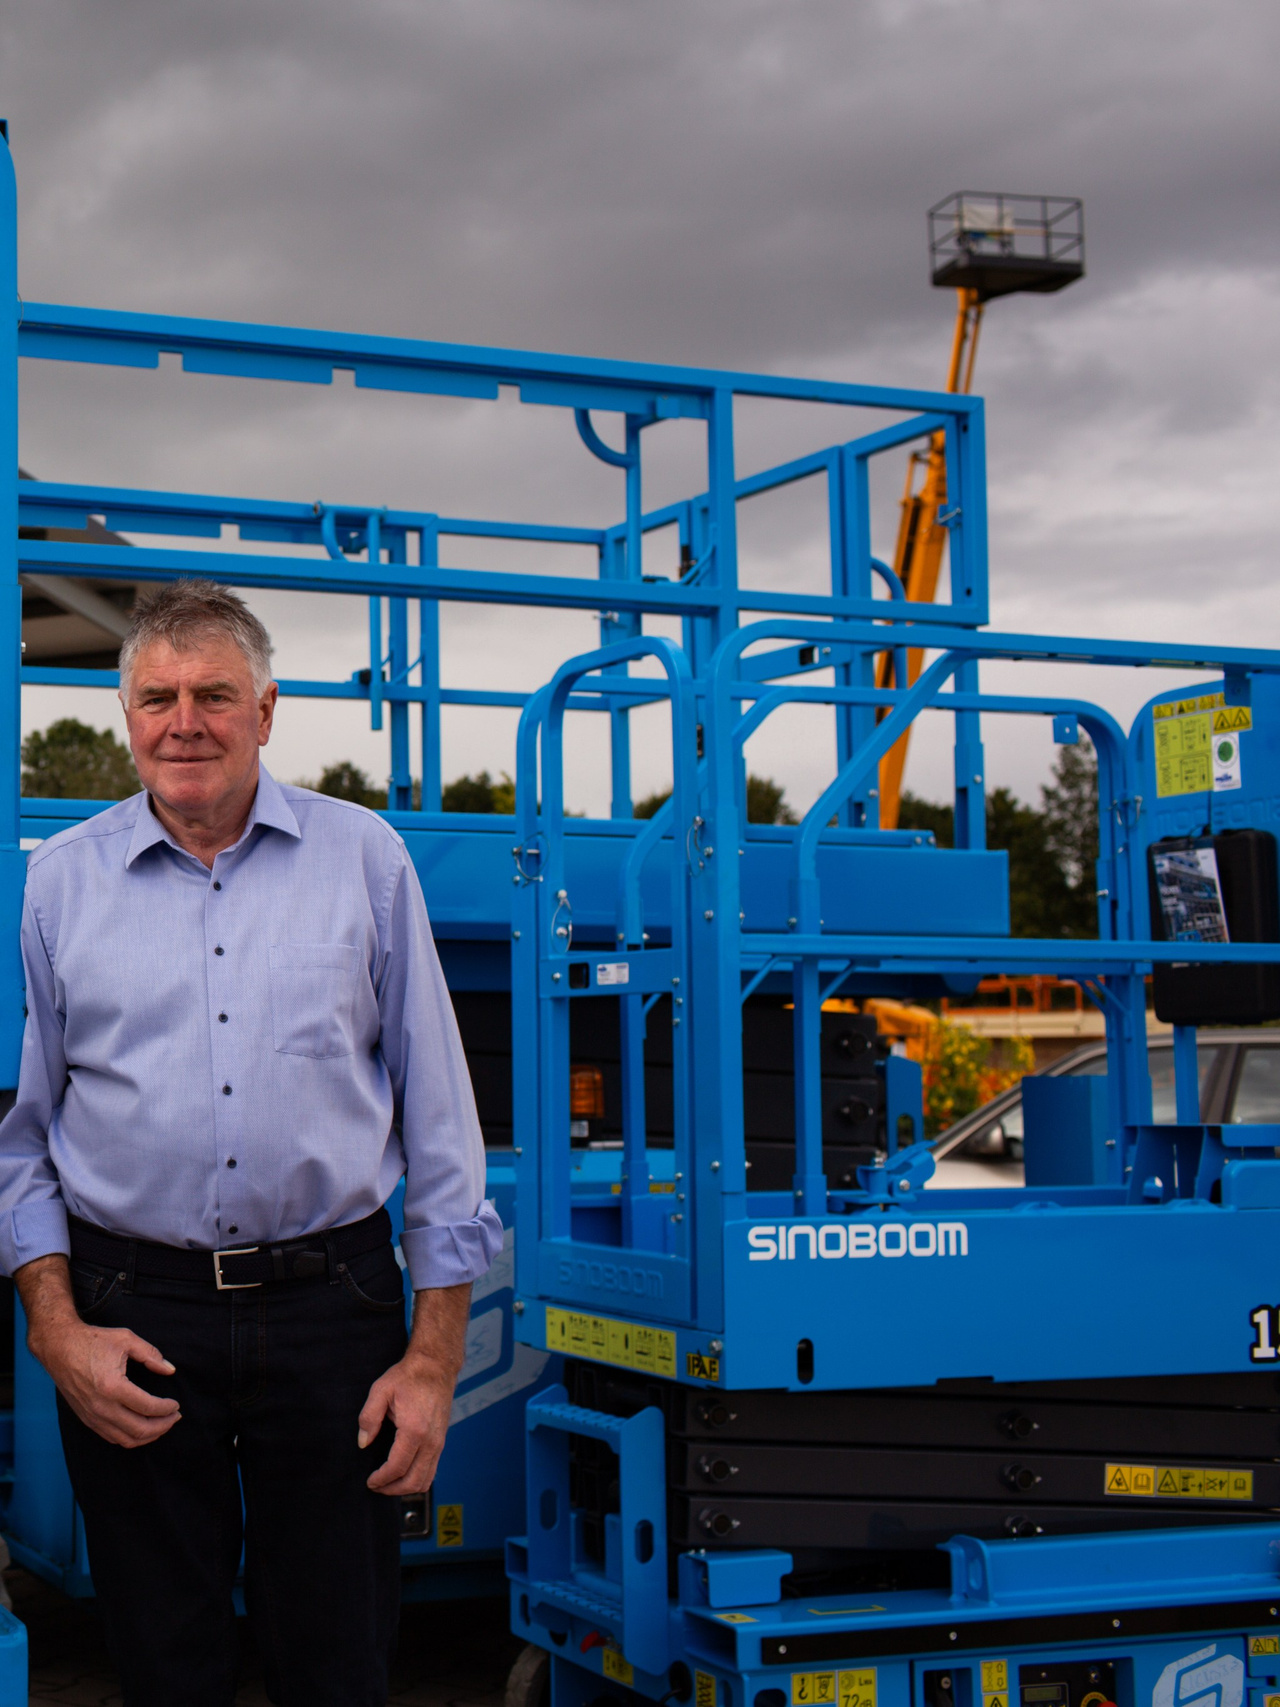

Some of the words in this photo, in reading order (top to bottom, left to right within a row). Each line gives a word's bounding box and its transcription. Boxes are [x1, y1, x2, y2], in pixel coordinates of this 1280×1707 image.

[748, 1222, 968, 1261] SINOBOOM
[1253, 1309, 1280, 1359] 1
[687, 1349, 718, 1380] IPAF
